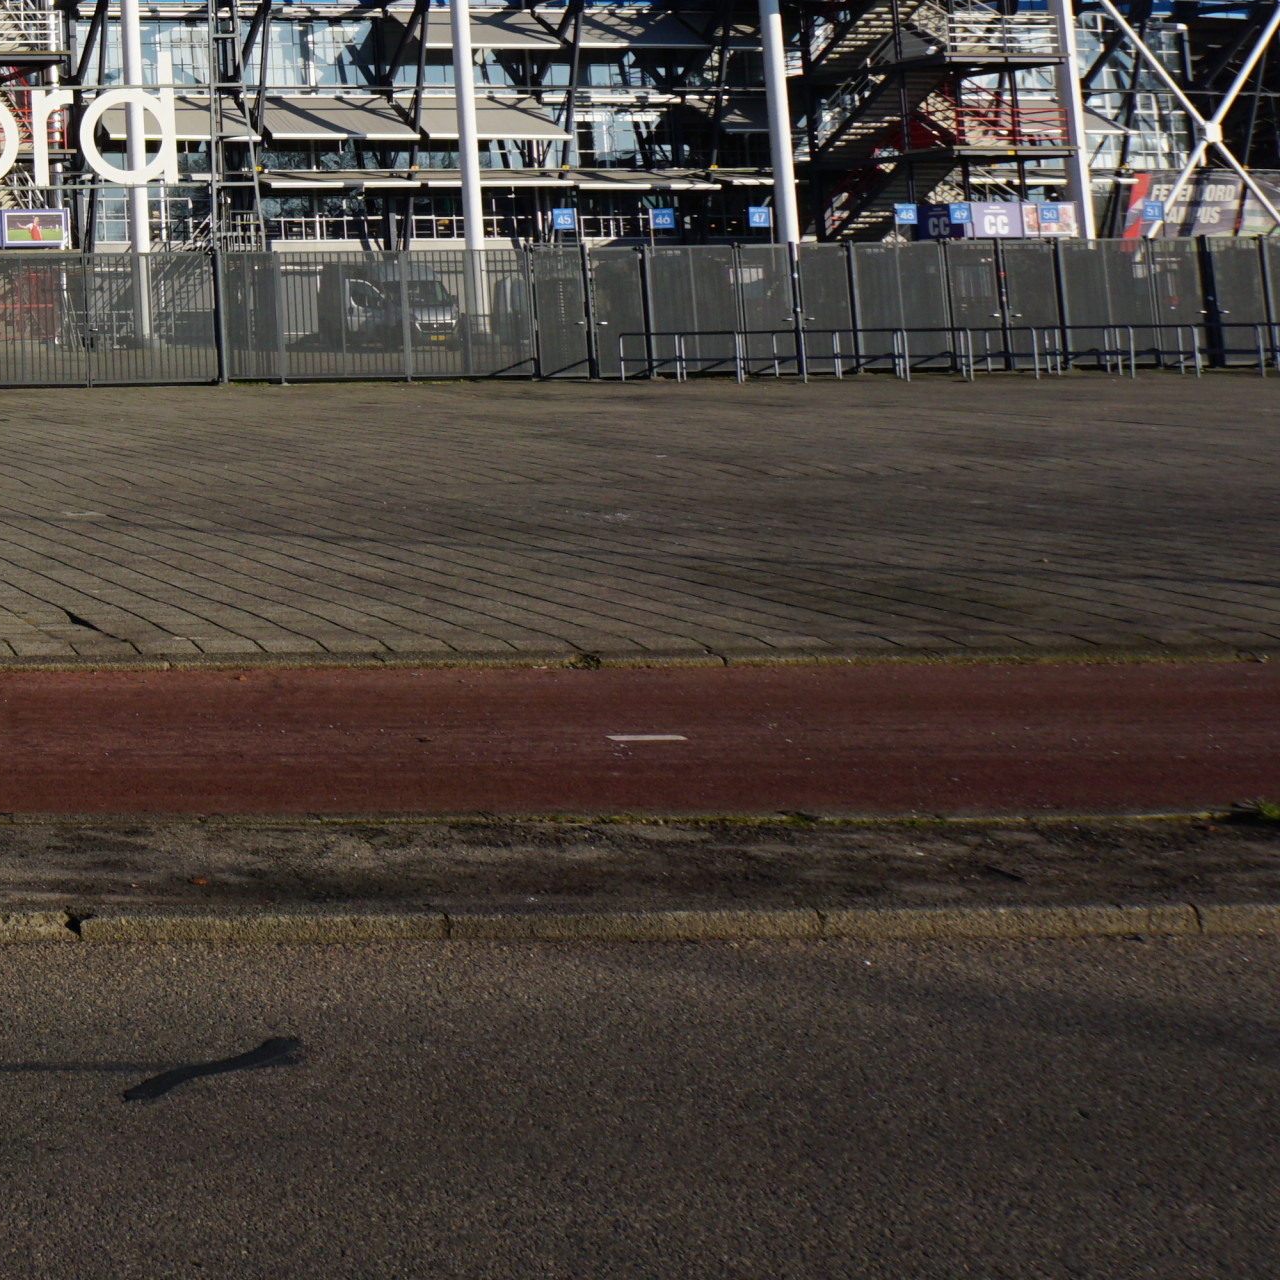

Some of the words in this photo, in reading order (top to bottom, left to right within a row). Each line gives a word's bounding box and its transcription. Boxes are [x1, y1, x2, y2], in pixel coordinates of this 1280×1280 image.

[899, 209, 915, 220] 48
[953, 210, 968, 220] 49
[1042, 210, 1057, 220] 50
[1146, 206, 1159, 217] 51
[557, 215, 571, 225] 45
[655, 215, 671, 225] 46
[752, 212, 766, 223] 47
[928, 217, 951, 236] CC
[983, 215, 1010, 235] CC
